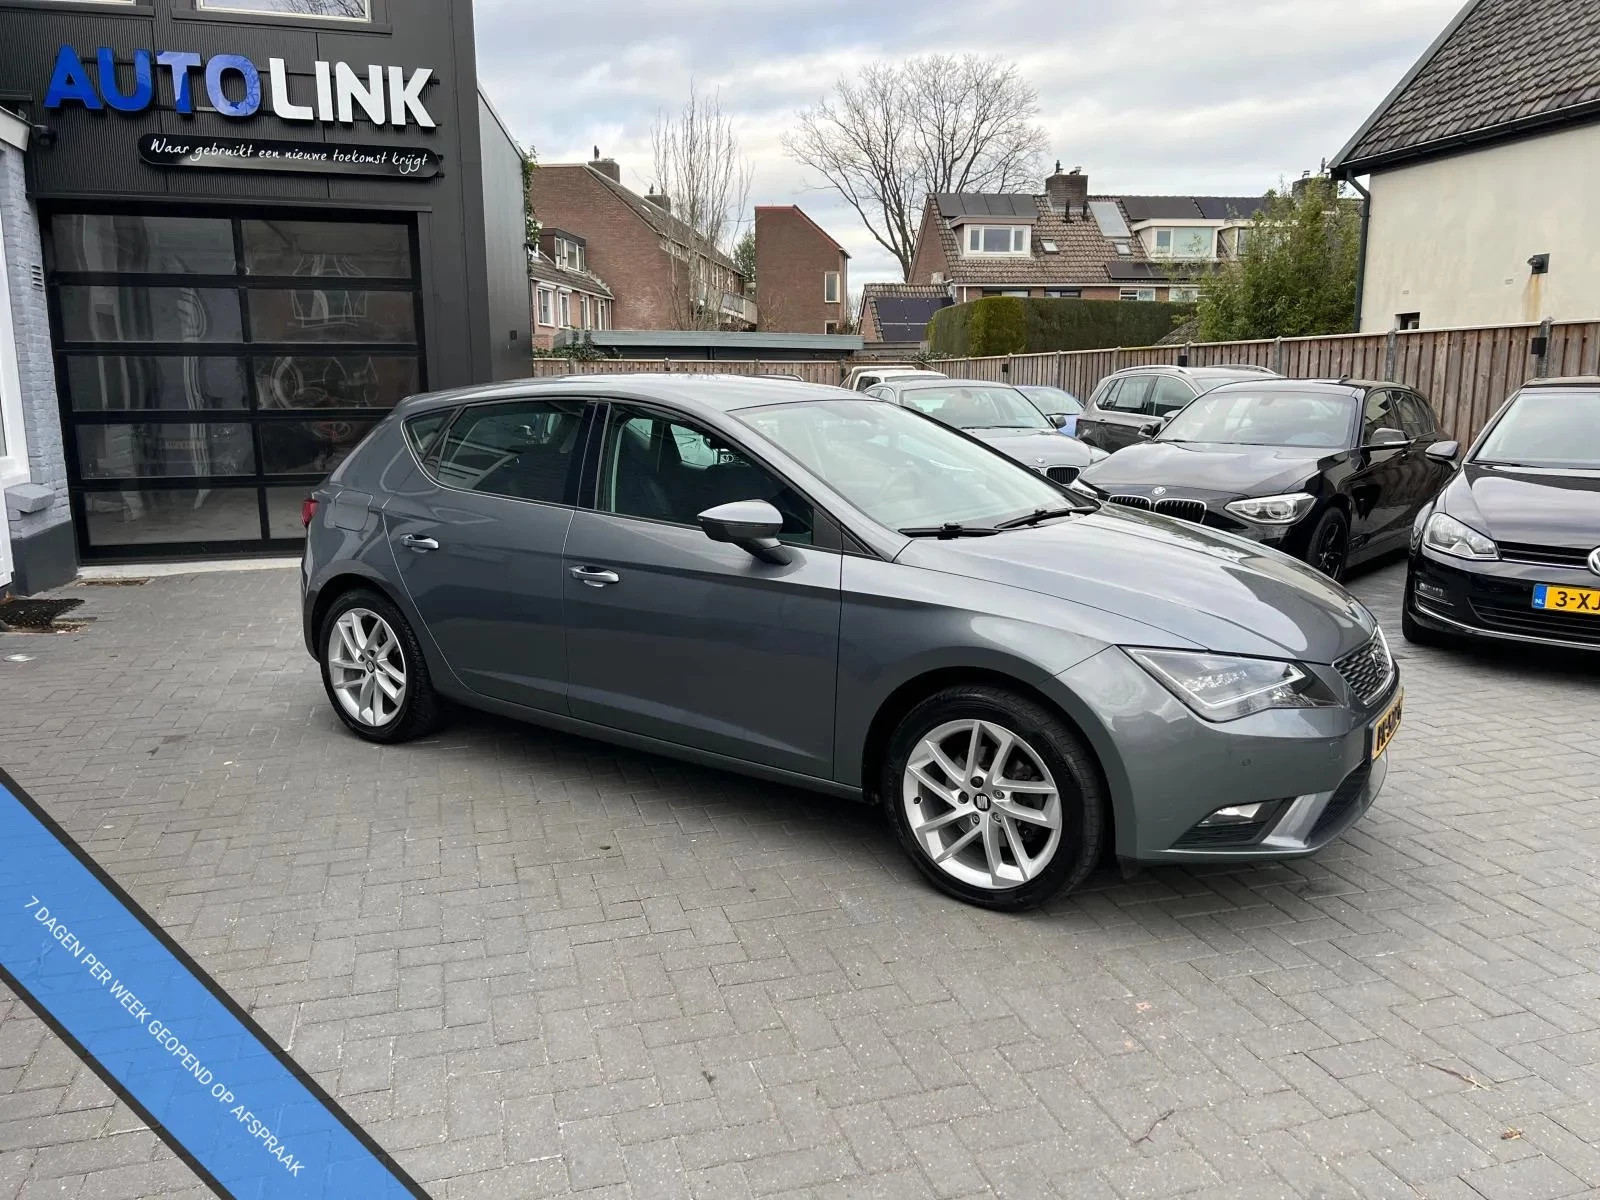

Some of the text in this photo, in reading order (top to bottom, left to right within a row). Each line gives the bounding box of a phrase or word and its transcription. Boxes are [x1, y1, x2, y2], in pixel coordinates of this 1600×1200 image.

[44, 44, 436, 127] AUTOLINK
[150, 138, 428, 174] Waar gebruikt een nieuwe toekomst krijgt
